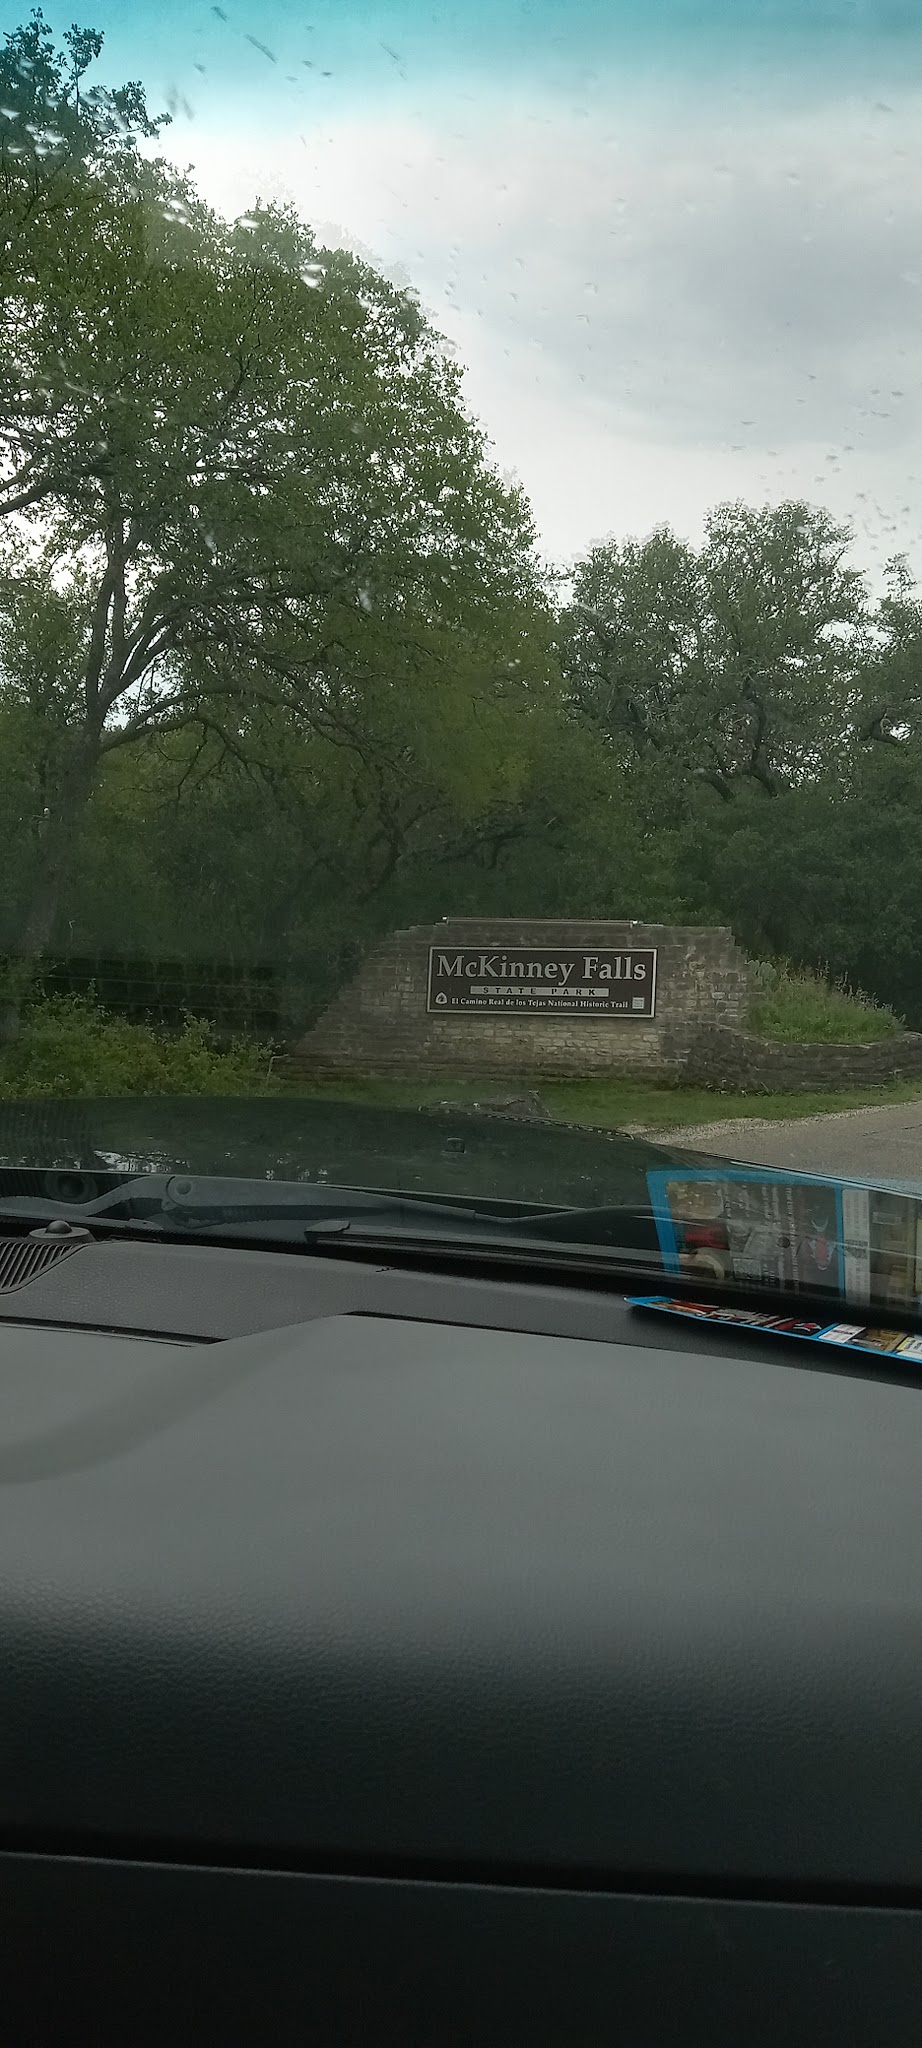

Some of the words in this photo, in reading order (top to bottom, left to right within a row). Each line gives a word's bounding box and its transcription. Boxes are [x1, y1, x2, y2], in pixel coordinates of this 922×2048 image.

[436, 955, 575, 985] McKinney
[581, 956, 646, 980] Falls
[505, 998, 514, 1006] de
[516, 998, 526, 1006] los
[528, 999, 546, 1007] Tejas
[548, 999, 578, 1007] National
[580, 1000, 609, 1008] Historic
